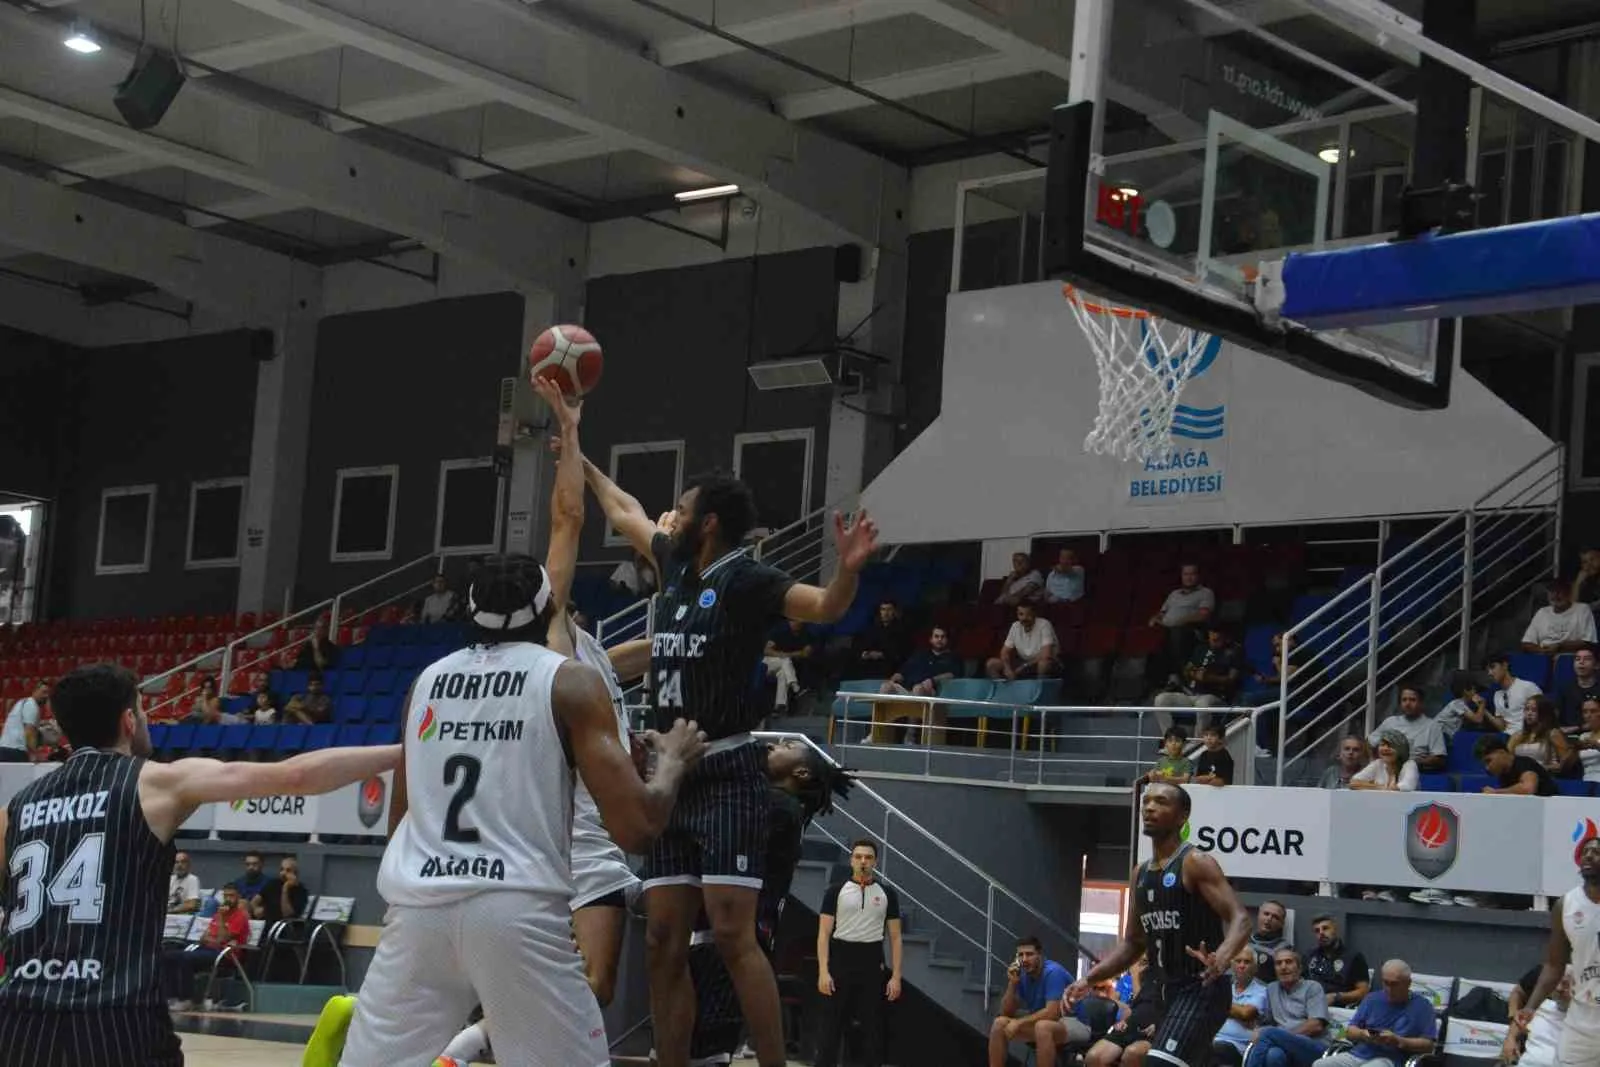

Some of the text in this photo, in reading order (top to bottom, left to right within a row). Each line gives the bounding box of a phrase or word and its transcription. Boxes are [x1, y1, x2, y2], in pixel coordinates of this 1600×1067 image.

[1130, 470, 1223, 497] BELEDİYESİ
[430, 670, 526, 699] HORTON
[658, 669, 683, 707] 24
[247, 796, 305, 815] SOCAR
[441, 753, 482, 843] 2
[1196, 826, 1304, 856] SOCAR
[7, 832, 106, 936] 34
